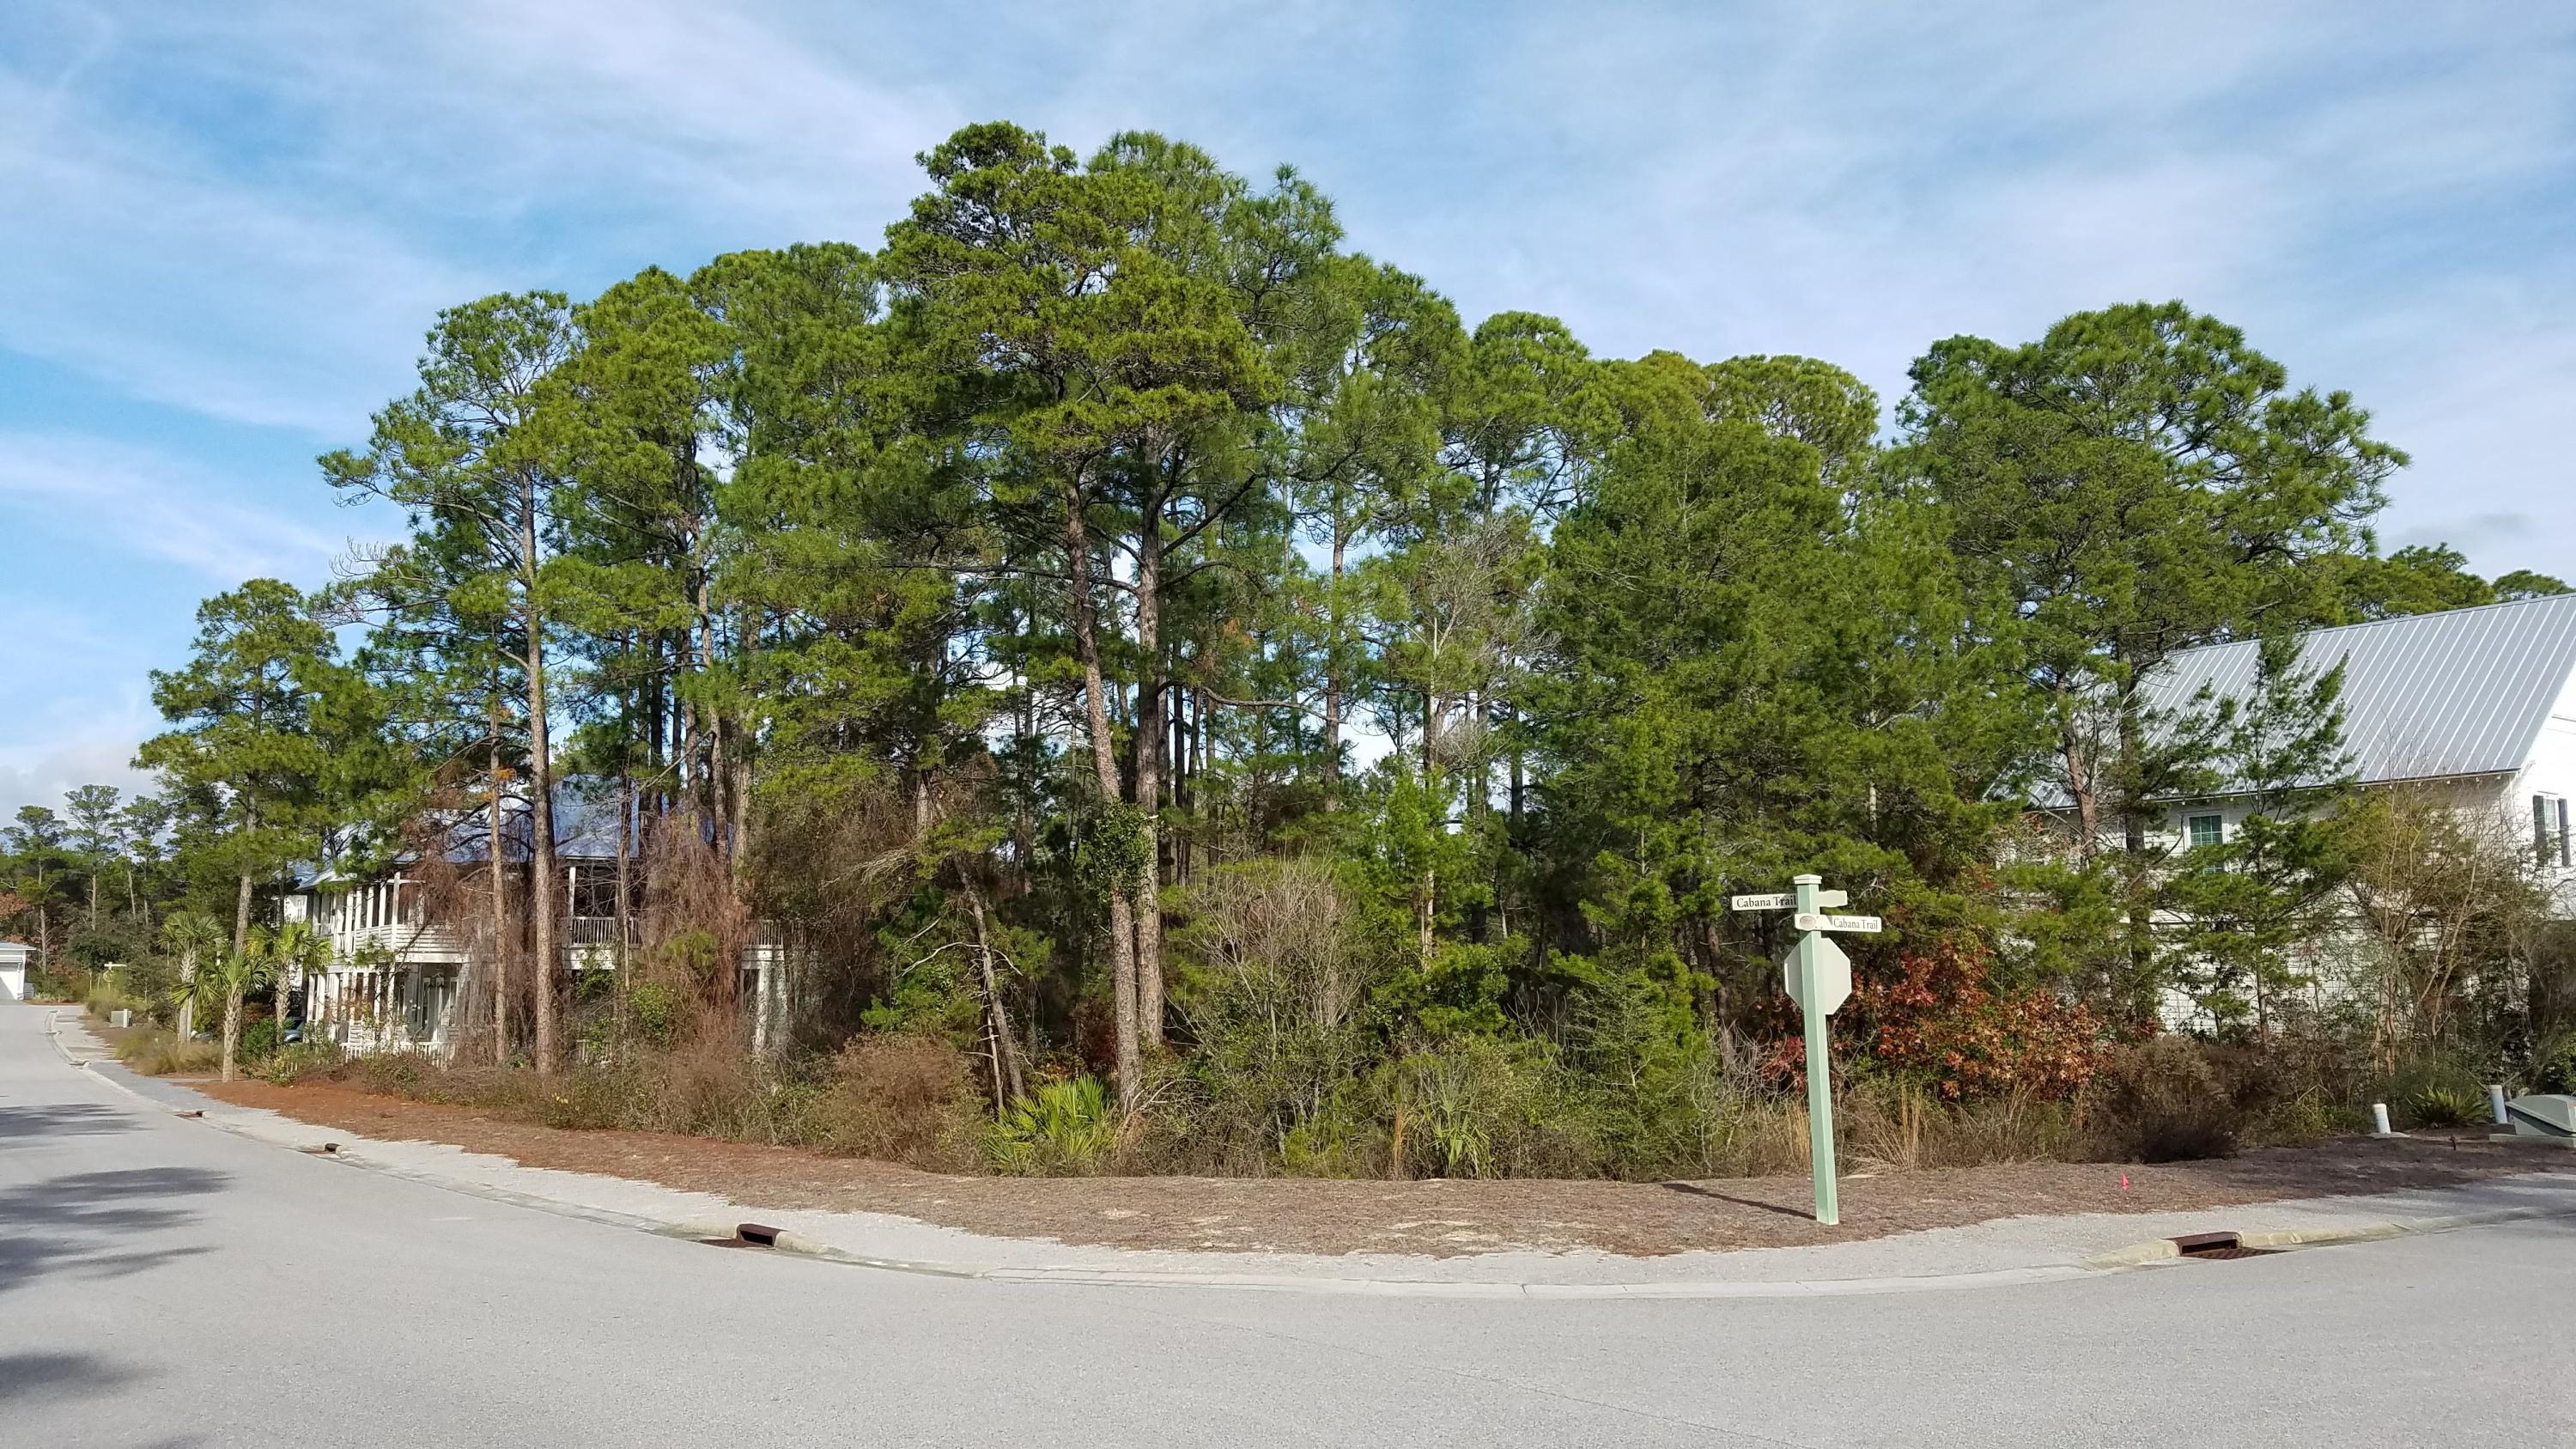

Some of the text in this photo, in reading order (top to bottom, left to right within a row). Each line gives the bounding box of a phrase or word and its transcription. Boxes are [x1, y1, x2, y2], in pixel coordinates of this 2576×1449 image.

[1736, 895, 1796, 908] Cabana Trail
[1833, 917, 1879, 929] Cabana Trail
